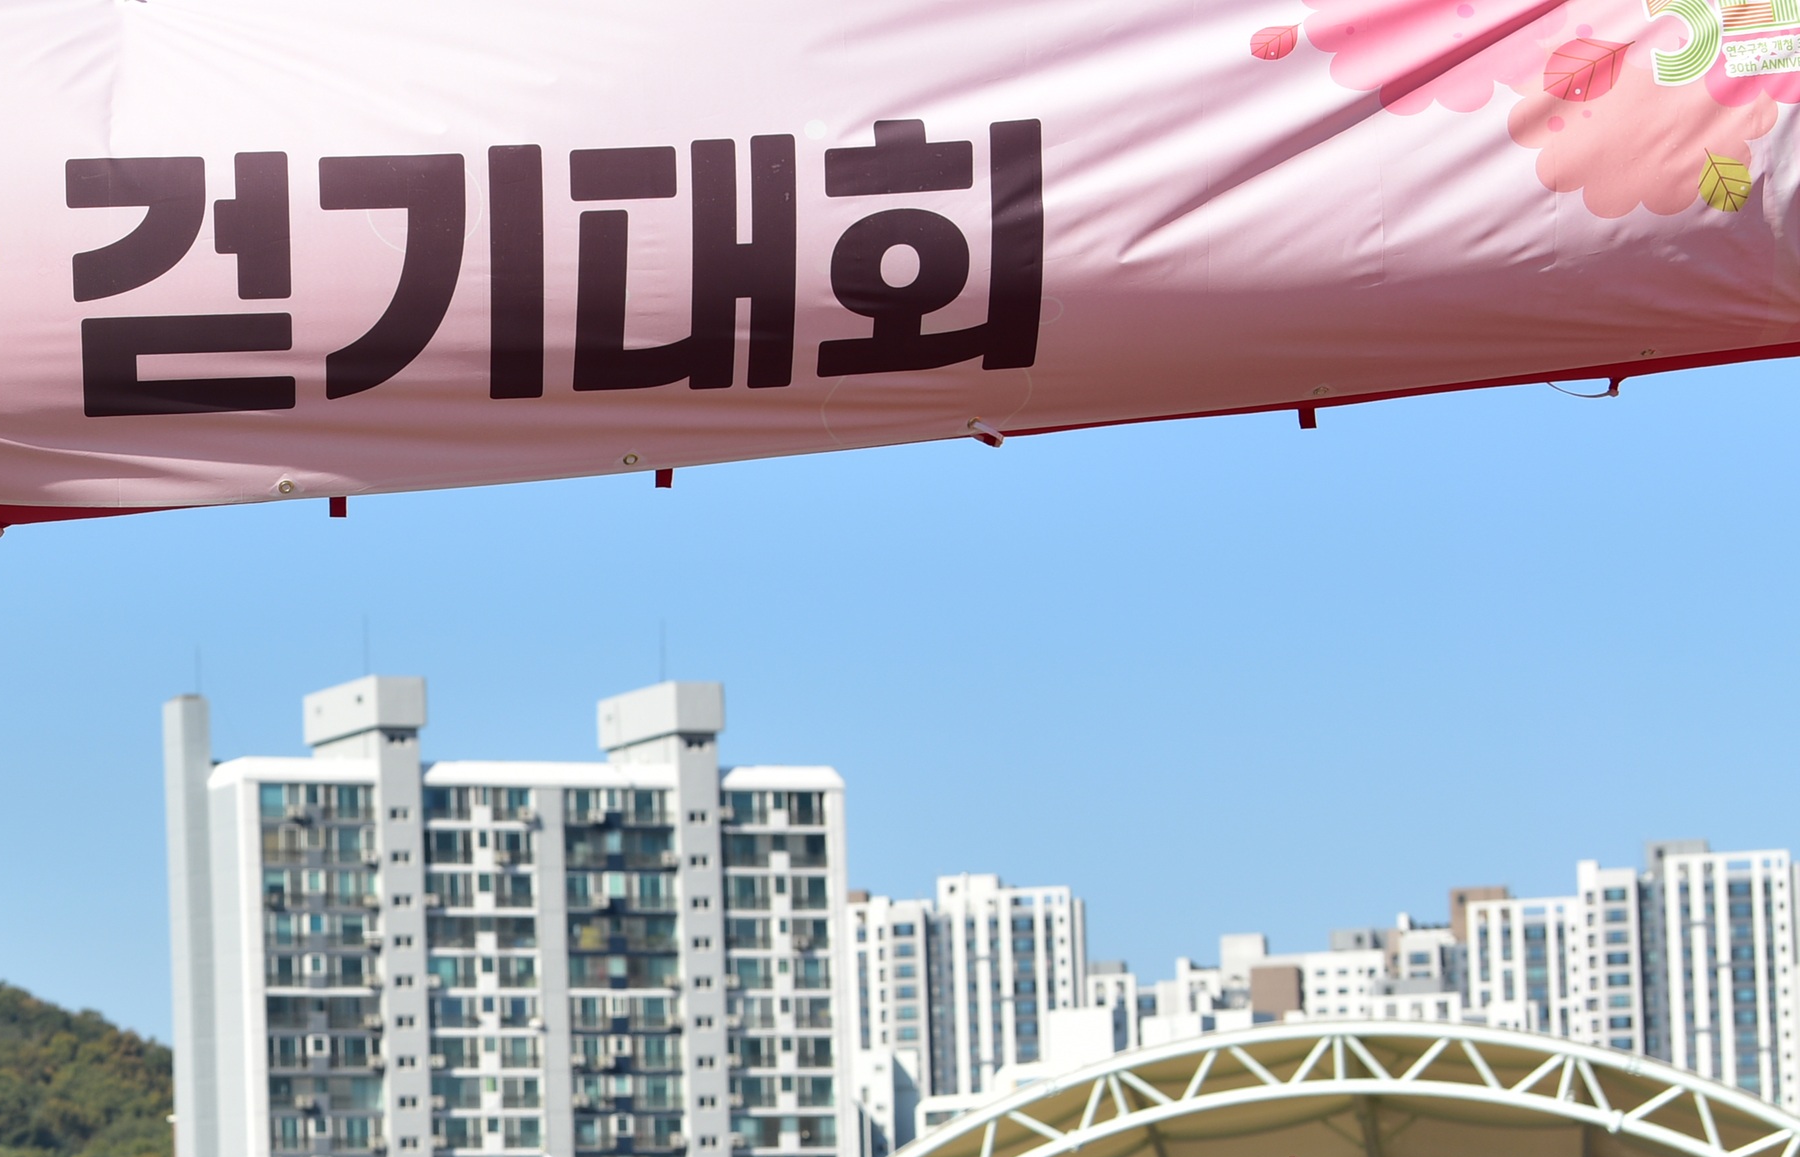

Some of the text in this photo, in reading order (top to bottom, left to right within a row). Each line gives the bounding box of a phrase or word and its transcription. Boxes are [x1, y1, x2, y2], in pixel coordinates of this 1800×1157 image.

[1726, 38, 1794, 58] 연수구청 개청
[1729, 60, 1758, 74] 30th
[65, 118, 1043, 418] 걷기대회
